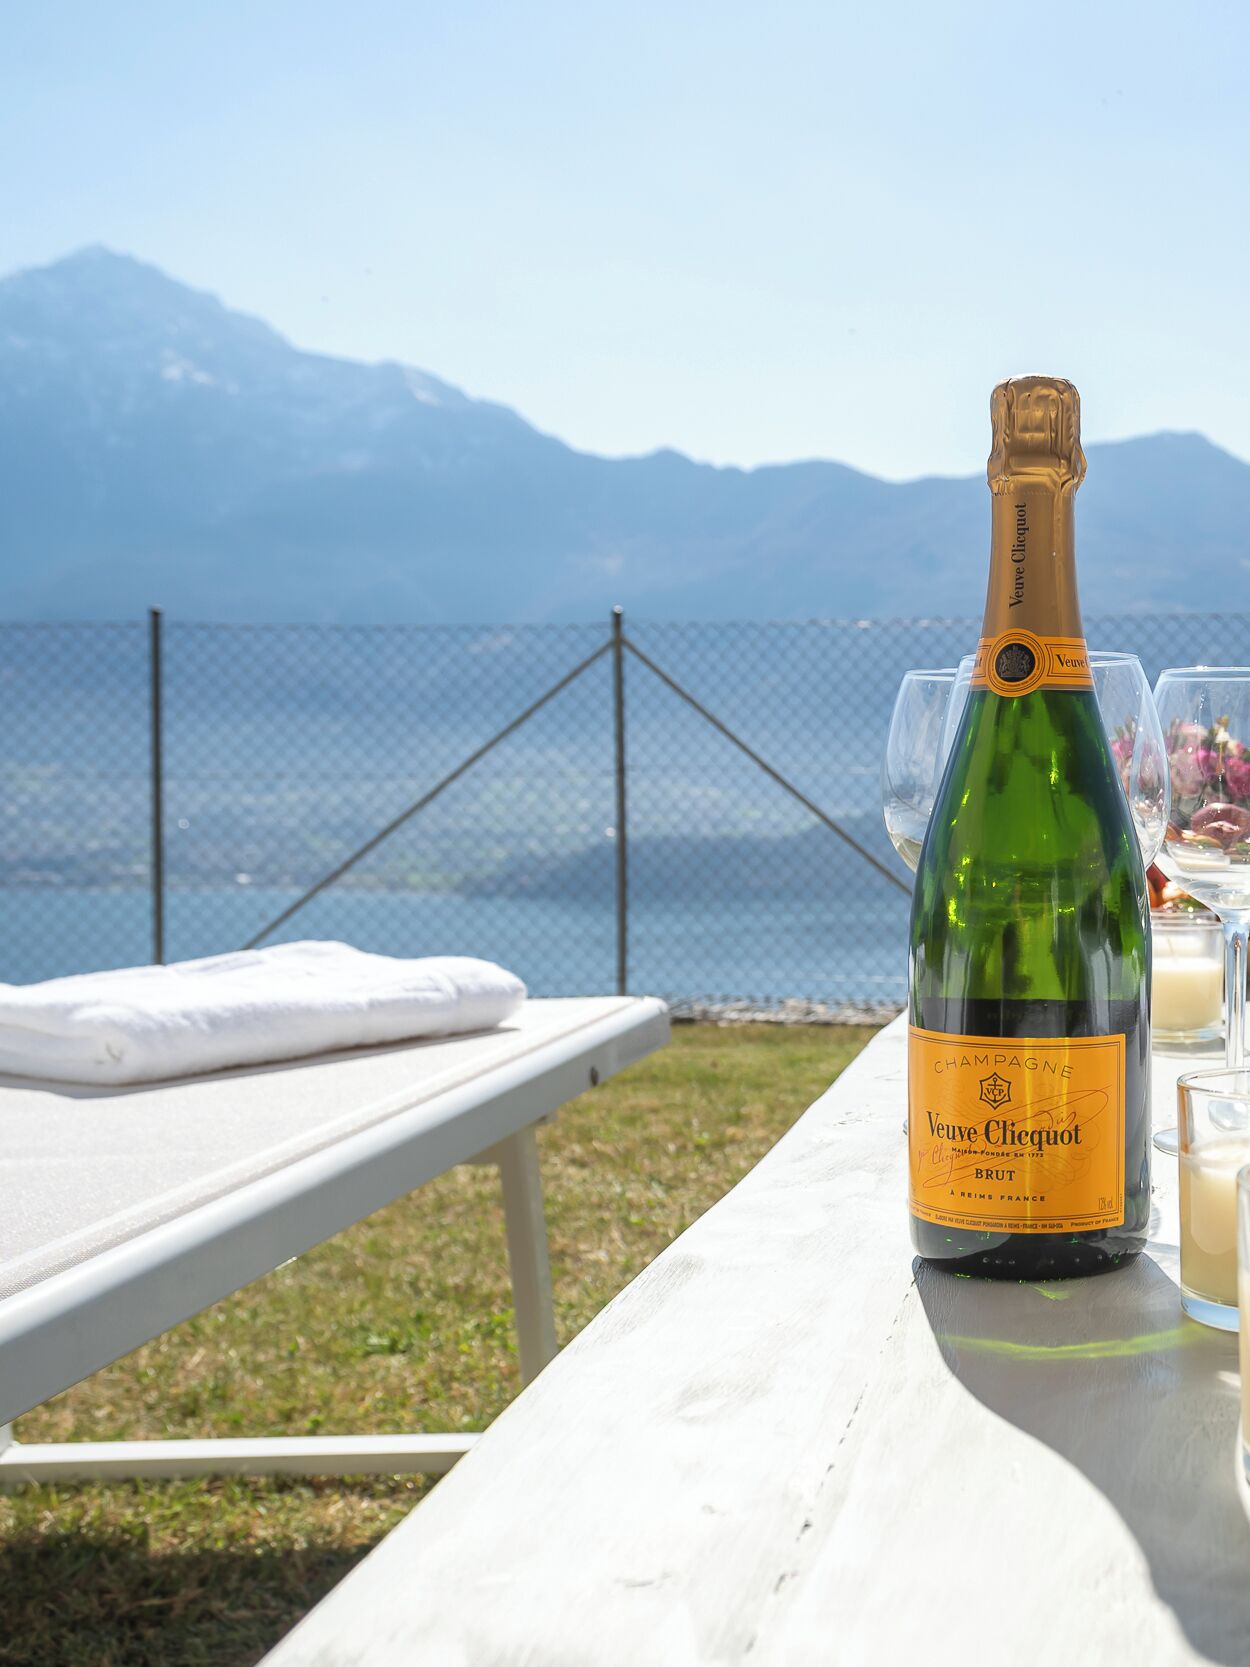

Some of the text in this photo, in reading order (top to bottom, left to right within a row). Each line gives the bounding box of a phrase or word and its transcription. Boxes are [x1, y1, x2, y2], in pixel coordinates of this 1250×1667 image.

[1009, 502, 1029, 609] Veuve Clicquot
[1056, 654, 1085, 667] Veuve
[934, 1054, 1074, 1079] CHAMPAGNE
[985, 1087, 1005, 1098] VCP
[926, 1110, 978, 1143] Veuve
[984, 1119, 1083, 1151] Clicquot
[975, 1168, 1016, 1182] BRUT
[960, 1191, 993, 1201] REIMS
[1000, 1193, 1046, 1202] FRANCE
